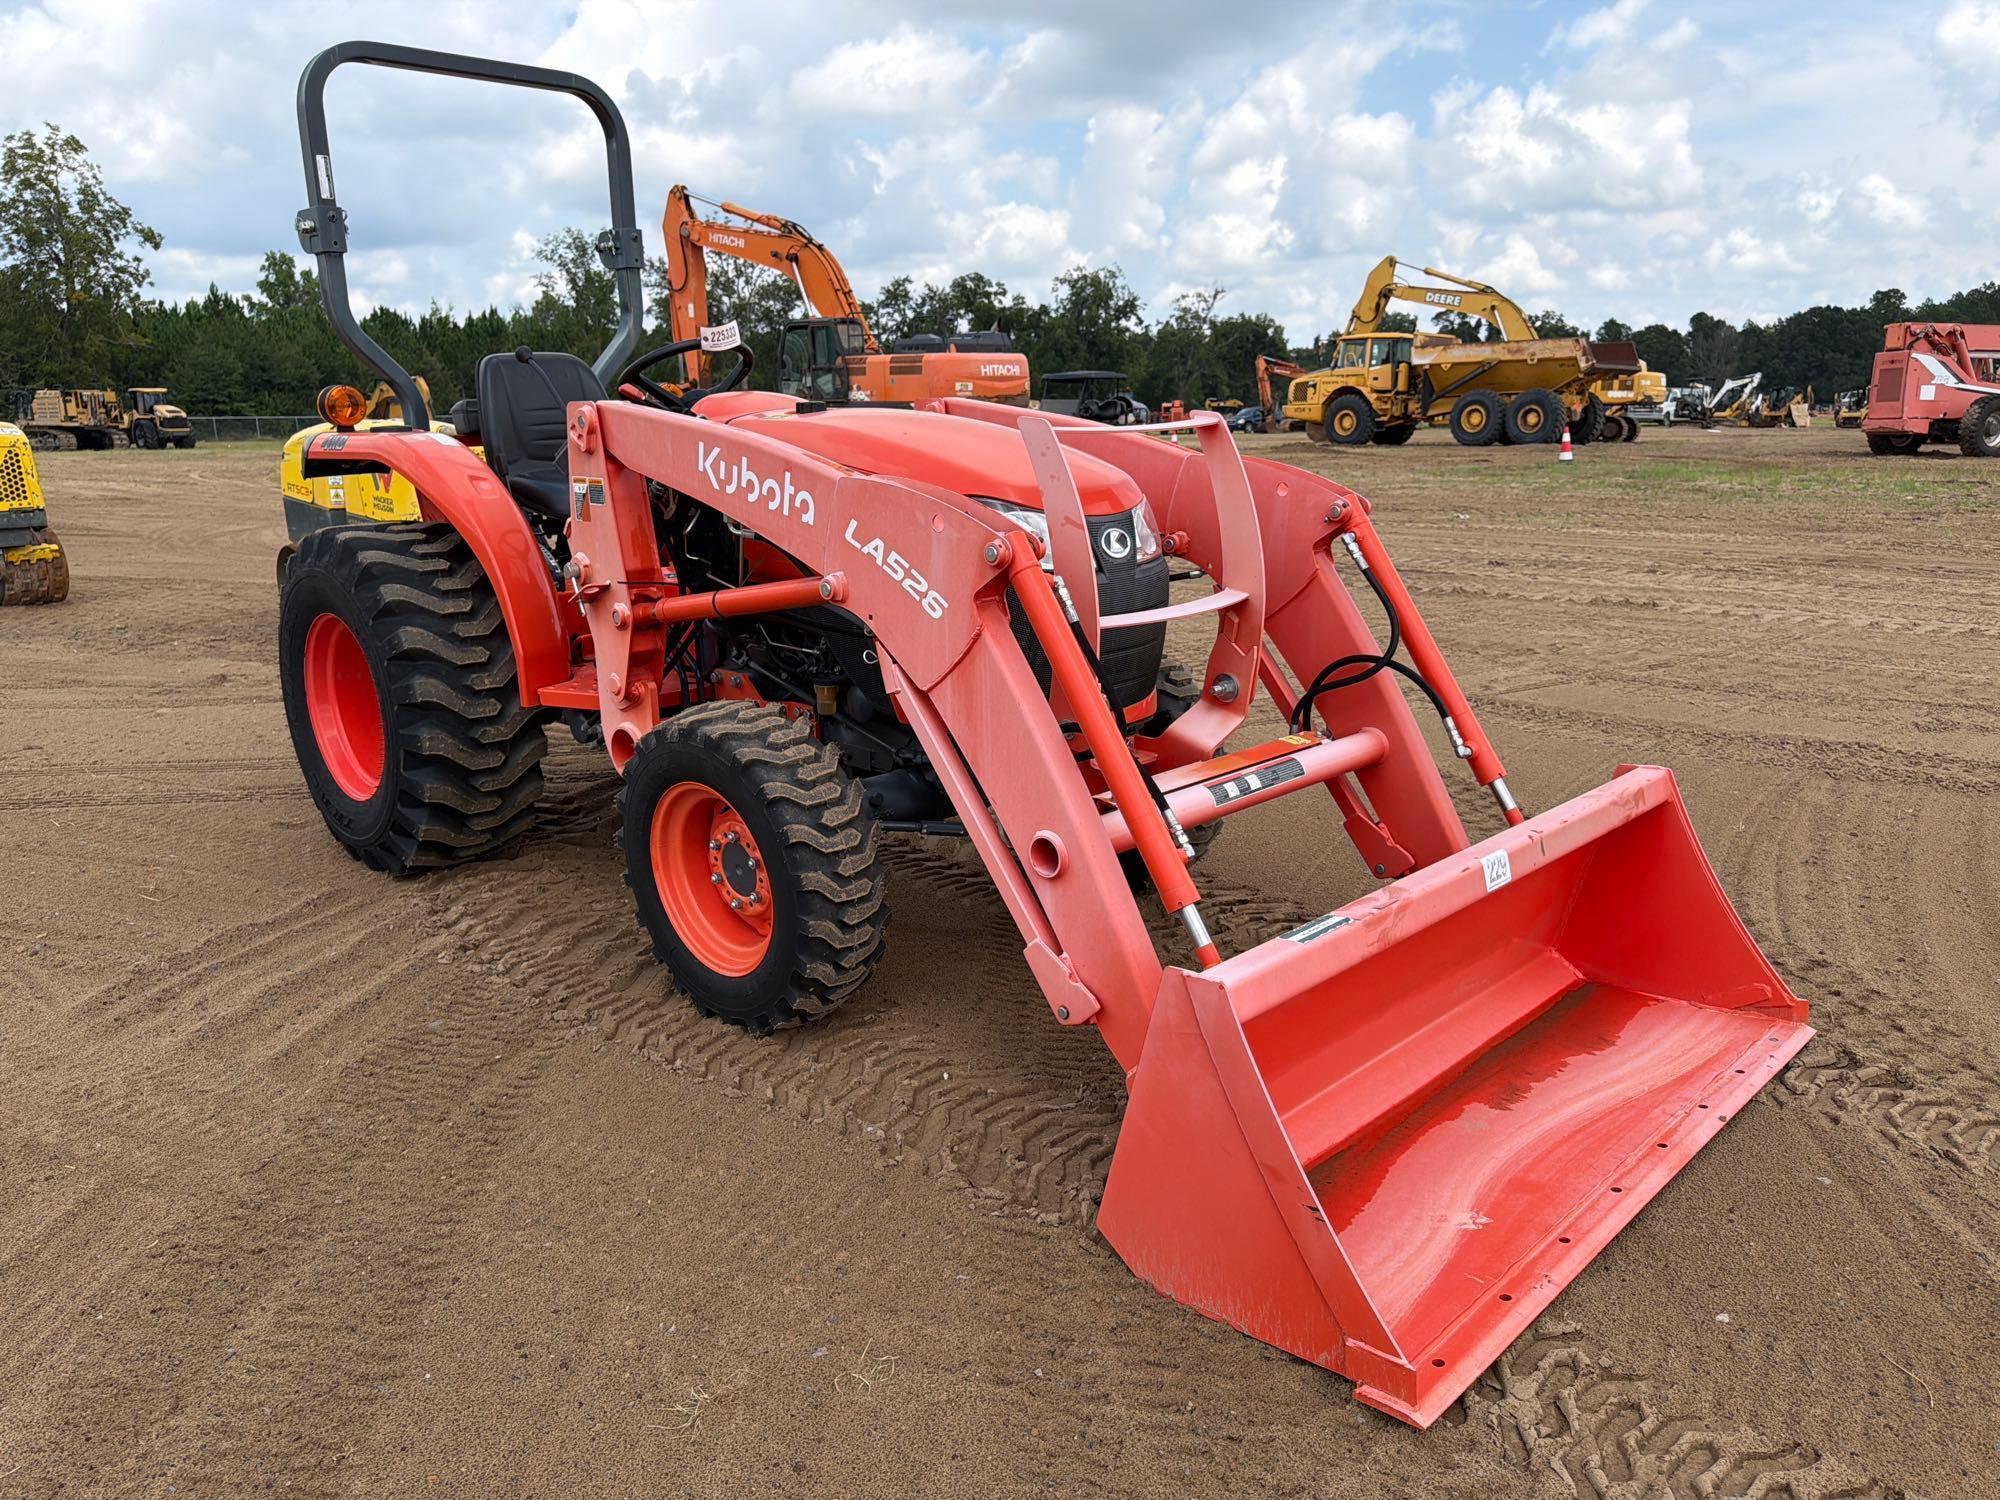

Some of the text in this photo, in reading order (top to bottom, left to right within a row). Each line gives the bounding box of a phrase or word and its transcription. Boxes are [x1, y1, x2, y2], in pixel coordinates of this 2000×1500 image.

[709, 232, 745, 248] HITACHI
[1425, 292, 1461, 306] DEERE
[981, 364, 1020, 376] HITACHI
[698, 441, 815, 526] Kubota
[372, 495, 394, 506] WACKER
[845, 518, 949, 619] LA526
